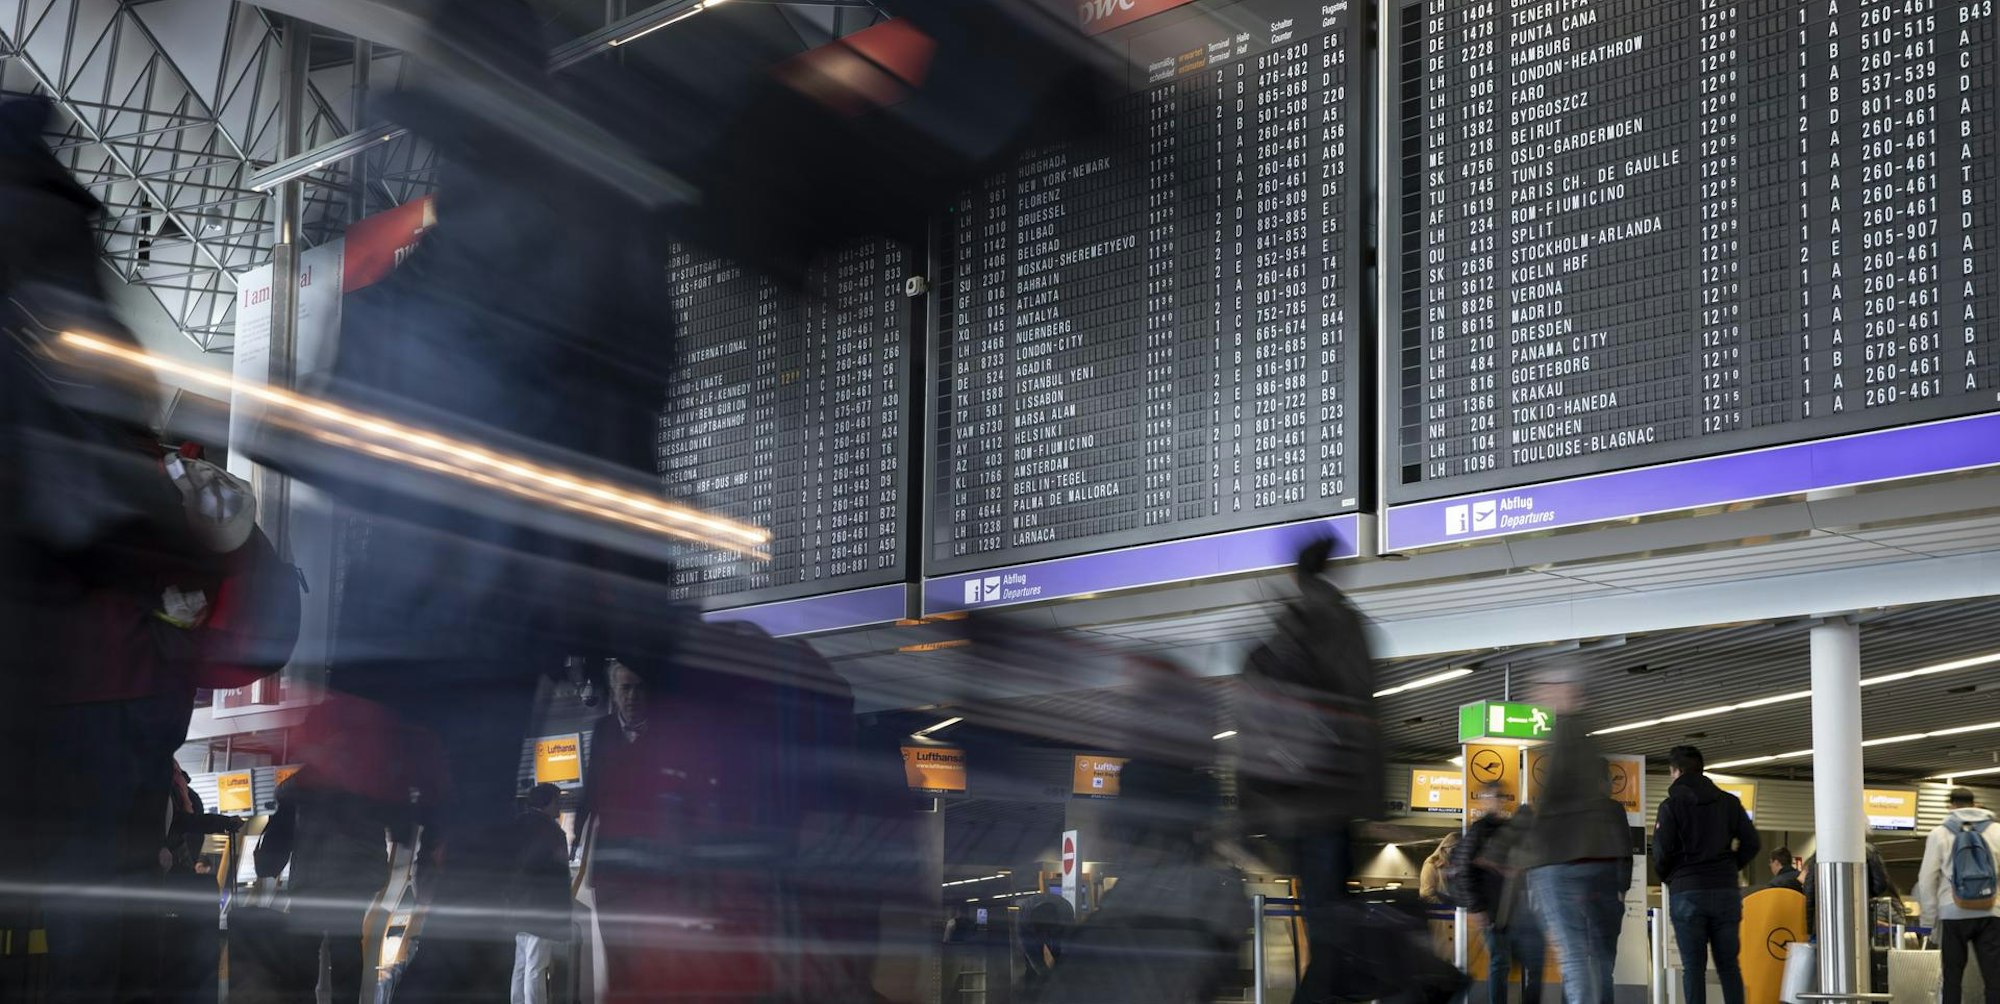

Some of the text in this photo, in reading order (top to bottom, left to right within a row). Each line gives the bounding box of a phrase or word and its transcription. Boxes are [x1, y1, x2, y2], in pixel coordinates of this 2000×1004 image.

[1271, 19, 1293, 32] Schalter
[1322, 1, 1347, 15] Flugsteig
[1323, 17, 1336, 27] Gate
[1208, 37, 1229, 52] Terminal
[1236, 32, 1250, 43] Halle
[1237, 44, 1248, 54] Hall
[1271, 31, 1292, 44] Counter
[1462, 9, 1596, 62] 2228 PUNTA CANA
[1463, 21, 1493, 42] 1478
[1209, 49, 1230, 64] Terminal
[1259, 43, 1307, 69] 810-820
[1259, 50, 1344, 86] 476-482 B45
[1470, 37, 1570, 78] 014 HAMBURG
[1512, 35, 1642, 86] LONDON-HEATHROW
[1511, 16, 1934, 145] BEIRUT 510-515
[1512, 84, 1544, 105] FARO
[1019, 79, 1307, 178] HURGHADA 865-868
[1463, 91, 1587, 138] 1382 BYDGOSZCZ
[1512, 61, 1935, 184] TUNIS 537-539
[1019, 87, 1344, 193] NEW YORK-NEWARK 501-508 Z20
[1462, 118, 1642, 177] 4756 OSLO-GARDERMOEN
[1511, 84, 1935, 204] PARIS CH. DE GAULLE 801-805
[1018, 124, 1344, 227] BRUESSEL A56
[1511, 107, 1934, 224] ROM-FIUMICINO 260-461
[1019, 188, 1060, 210] FLORENZ
[1512, 129, 1934, 244] SPLIT 260-461
[1017, 207, 1306, 293] BAHRAIN 883-885
[1018, 189, 1306, 276] MOSKAU-SHEREMETYEVO 806-809
[1018, 223, 1053, 244] BILBAO
[1018, 238, 1059, 260] BELGRAD
[1462, 175, 1935, 295] 3612 KOELN HBF 260-461
[1511, 216, 1661, 264] STOCKHOLM-ARLANDA
[1462, 198, 1935, 314] 8826 VERONA 260-461
[1512, 220, 1937, 323] MADRID 905-907
[252, 287, 270, 305] am
[1017, 244, 1305, 326] ANTALYA 952-954
[1017, 289, 1058, 309] ATLANTA
[1512, 243, 1936, 343] DRESDEN 260-461
[1016, 300, 1305, 377] AGADIR 752-785
[1017, 281, 1306, 360] LONDON-CITY 901-903
[1017, 320, 1070, 343] NUERNBERG
[1470, 288, 1937, 391] 816 GOETEBORG 260-461
[836, 353, 871, 371] 260-461
[1017, 318, 1305, 393] ISTANBUL YENI 665-674
[1512, 332, 1606, 363] PANAMA CITY
[1512, 311, 1937, 403] KRAKAU 260-461
[1015, 355, 1305, 427] MARSA ALAM 916-917
[1016, 336, 1305, 410] LISSABON 682-685
[1512, 334, 1938, 423] TOKIO-HANEDA 678-681
[658, 384, 871, 443] ERFURT HAUPTBAHNHOF 260-461
[659, 414, 671, 428] TEL
[718, 399, 746, 415] GURION
[836, 368, 871, 386] 791-794
[1015, 374, 1305, 443] HELSINKI 986-988
[1512, 356, 1938, 443] MUENCHEN 260-461
[658, 399, 871, 457] THESSALONIKI 675-677
[834, 416, 870, 433] 260-461
[834, 431, 870, 449] 260-461
[1015, 392, 1305, 460] ROM-FIUMICINO 720-722
[1513, 379, 1939, 463] TOULOUSE-BLAGNAC 260-461
[734, 472, 748, 484] HBF
[833, 478, 869, 496] 941-943
[1014, 456, 1068, 477] AMSTERDAM
[1014, 442, 1342, 510] PALMA DE MALLORCA 941-943 D40
[1014, 471, 1086, 495] BERLIN-TEGEL
[1013, 514, 1037, 528] WIEN
[1500, 496, 1533, 511] Abflug
[1500, 511, 1554, 528] Departures
[1013, 528, 1055, 545] LARNACA
[704, 565, 736, 581] EXUPERY
[831, 559, 867, 575] 880-881
[1003, 573, 1026, 585] Abflug
[1003, 586, 1041, 599] Departures
[548, 744, 576, 754] Lufthansa
[917, 752, 964, 762] Lufthansa
